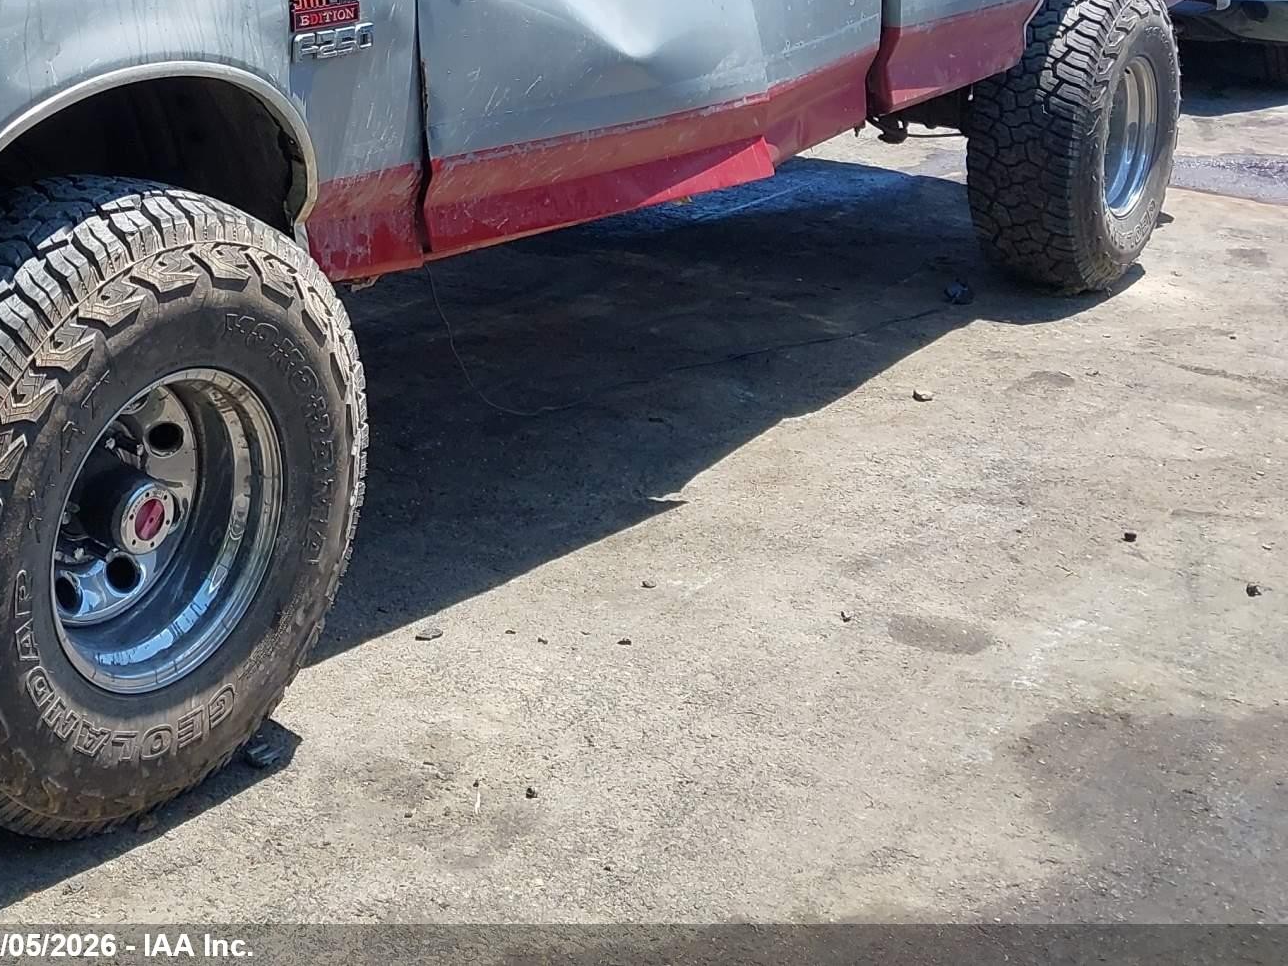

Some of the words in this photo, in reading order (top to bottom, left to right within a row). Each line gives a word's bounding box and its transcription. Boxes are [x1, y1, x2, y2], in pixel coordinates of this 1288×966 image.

[299, 7, 355, 27] EDITION
[292, 22, 374, 62] F250
[14, 569, 236, 762] GEOLANDAR
